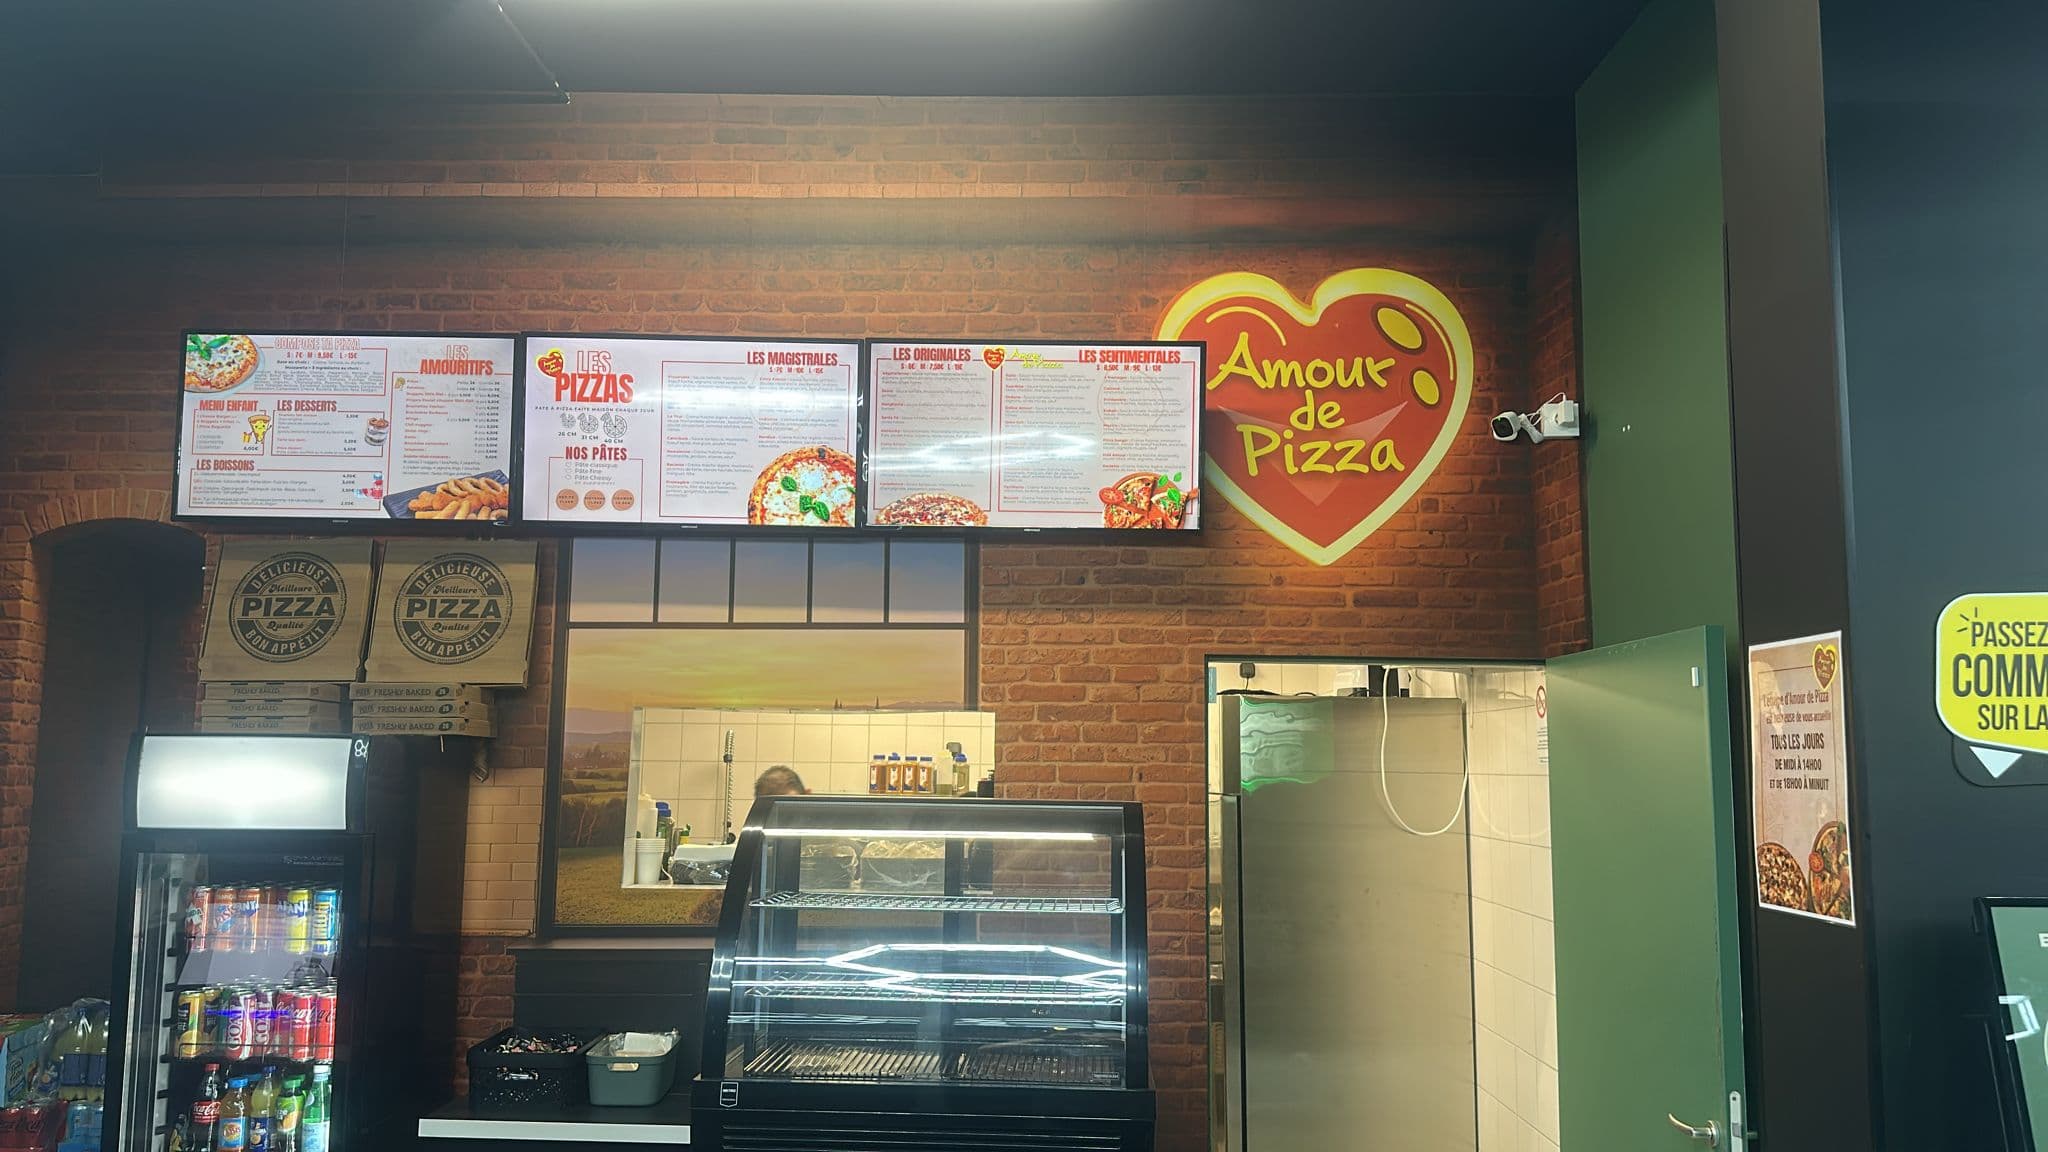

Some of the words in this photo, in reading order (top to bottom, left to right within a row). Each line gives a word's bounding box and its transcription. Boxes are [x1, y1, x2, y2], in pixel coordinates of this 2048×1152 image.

[446, 345, 468, 360] LES
[747, 352, 764, 364] LES
[768, 352, 838, 366] MAGISTRALES
[893, 348, 910, 360] LES
[914, 348, 971, 362] ORIGINALES
[1079, 350, 1096, 363] LES
[1099, 350, 1180, 363] SENTIMENTALES
[1207, 331, 1395, 390] Amour
[420, 359, 493, 376] AMOURITIFS
[576, 350, 612, 374] LES
[555, 373, 634, 404] PIZZAS
[200, 400, 225, 411] MENU
[227, 400, 258, 412] ENFANT
[277, 400, 294, 412] LES
[295, 400, 336, 412] DESSERTS
[1290, 389, 1345, 431] de
[566, 446, 588, 460] NOS
[592, 444, 627, 460] PÂTES
[1236, 424, 1405, 476] Pizza
[196, 460, 212, 470] LES
[214, 460, 254, 471] BOISSONS
[242, 597, 336, 617] PIZZA
[406, 598, 501, 618] PIZZA
[267, 620, 304, 631] Qualité
[432, 622, 470, 633] Qualité
[246, 629, 269, 650] BON
[410, 631, 436, 652] BON
[1971, 622, 2048, 647] PASSEZ
[1807, 690, 1814, 703] de
[1815, 690, 1829, 703] Pizza
[1803, 713, 1814, 722] vous
[1978, 704, 2018, 730] SUR
[2025, 704, 2048, 730] LA
[1771, 734, 1787, 750] TOUS
[1788, 734, 1800, 750] LES
[1802, 733, 1824, 750] JOURS
[1774, 759, 1782, 770] DE
[1784, 759, 1796, 770] MIDI
[1803, 759, 1822, 770] 14H00
[1770, 779, 1775, 788] ET
[1776, 779, 1782, 789] DE
[1784, 778, 1802, 789] 18H00
[1809, 778, 1829, 790] MINUIT
